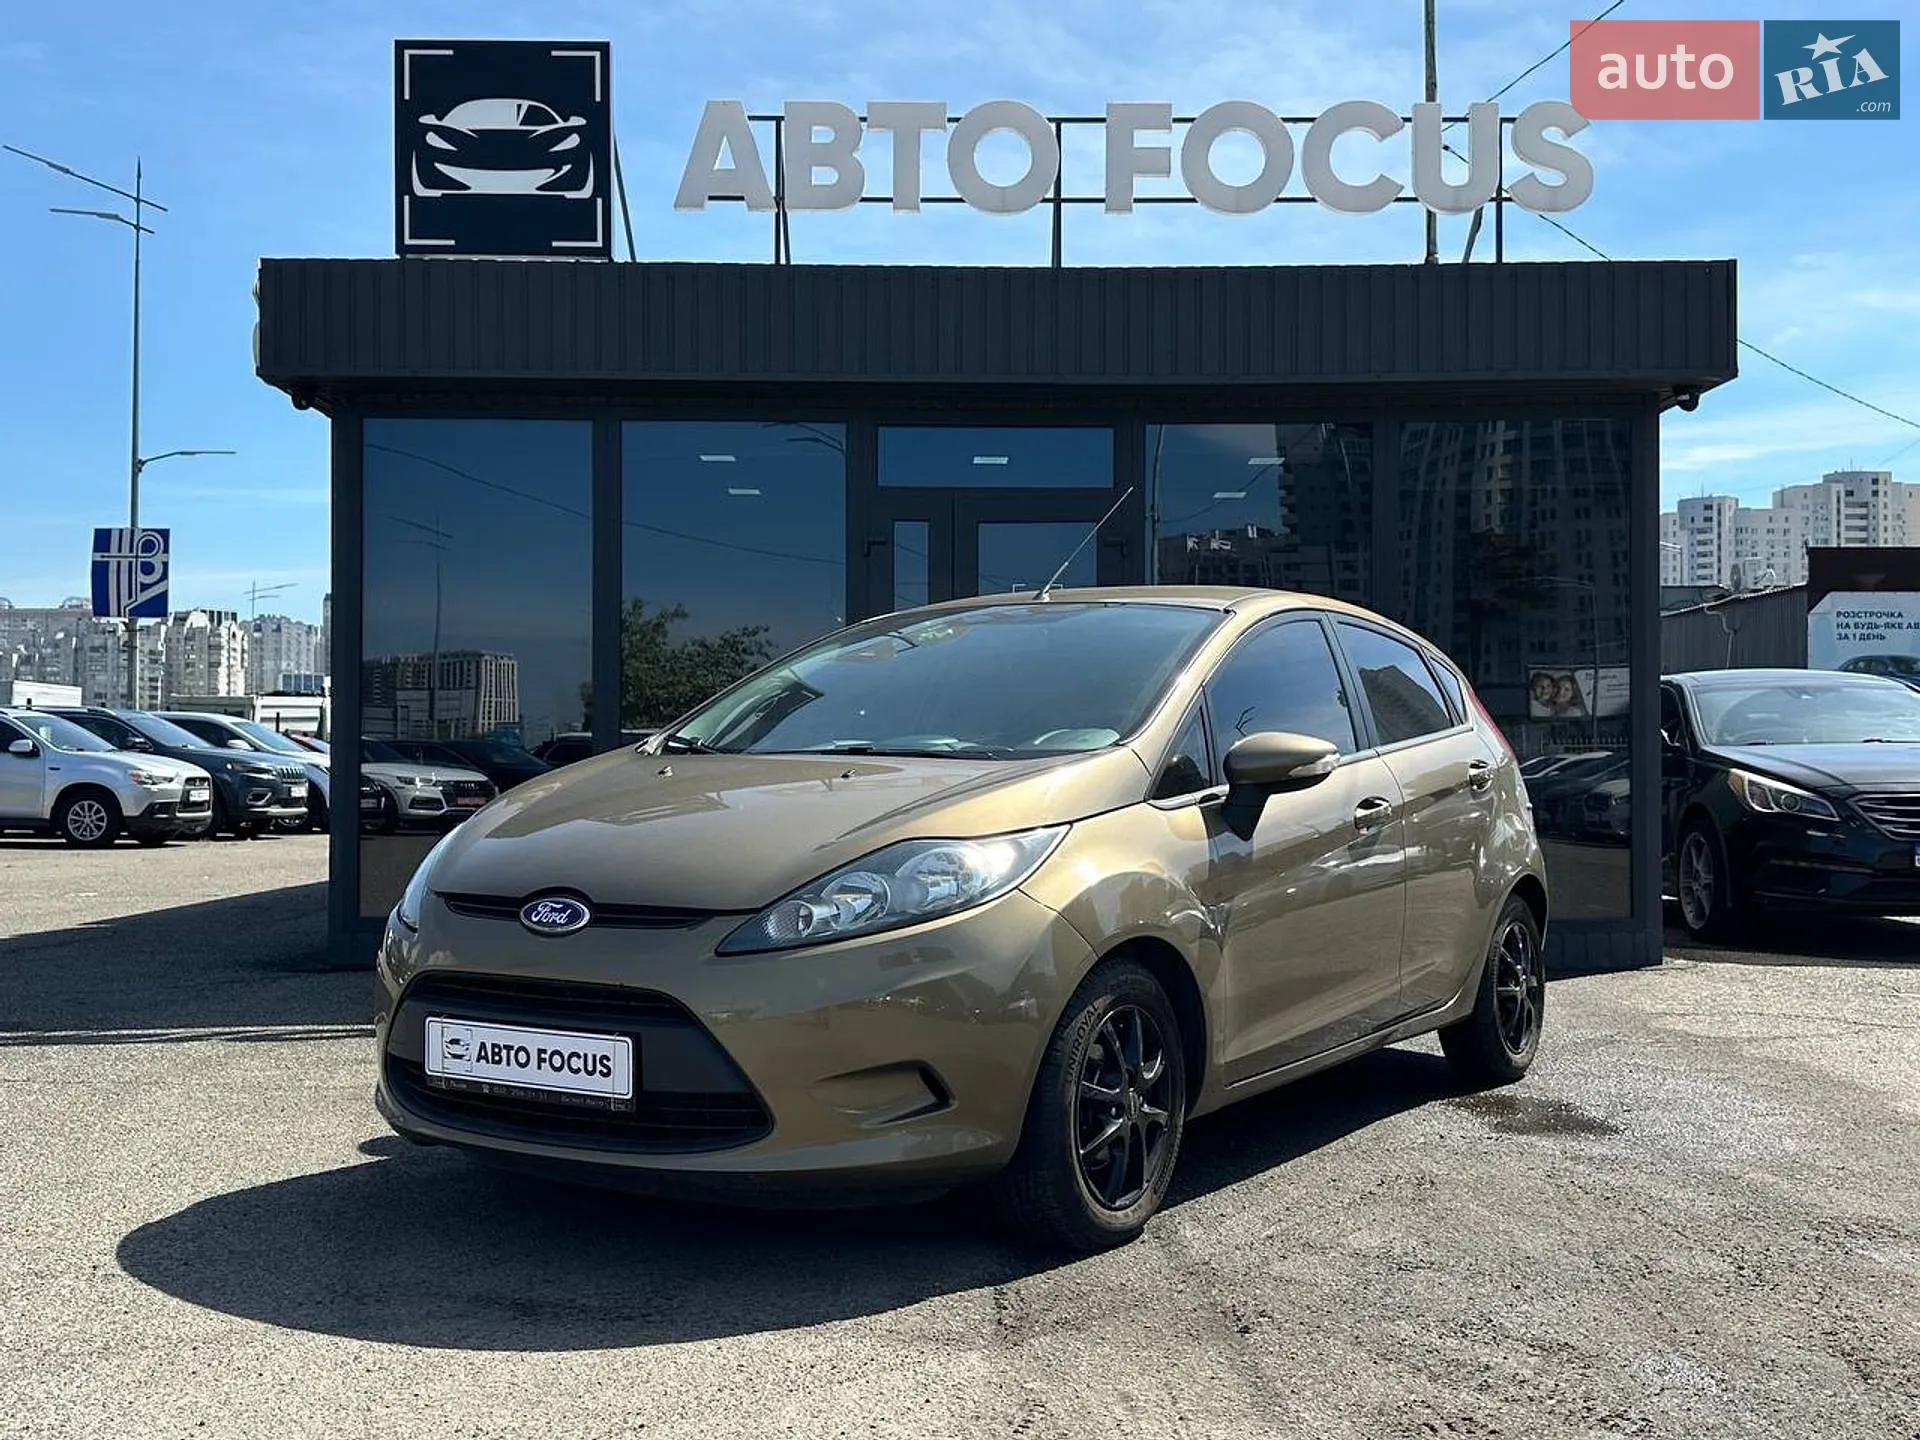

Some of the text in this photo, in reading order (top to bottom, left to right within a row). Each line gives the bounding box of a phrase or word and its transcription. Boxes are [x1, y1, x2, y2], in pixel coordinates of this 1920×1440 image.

[674, 99, 1594, 215] АВТО FOCUS
[1836, 610, 1903, 618] РОЗСТРОЧКА
[1836, 622, 1850, 630] НА
[1836, 633, 1850, 641] ЗА
[1858, 633, 1886, 641] ДЕНЬ
[531, 901, 572, 924] Ford
[476, 1041, 612, 1078] АВТО FOCUS
